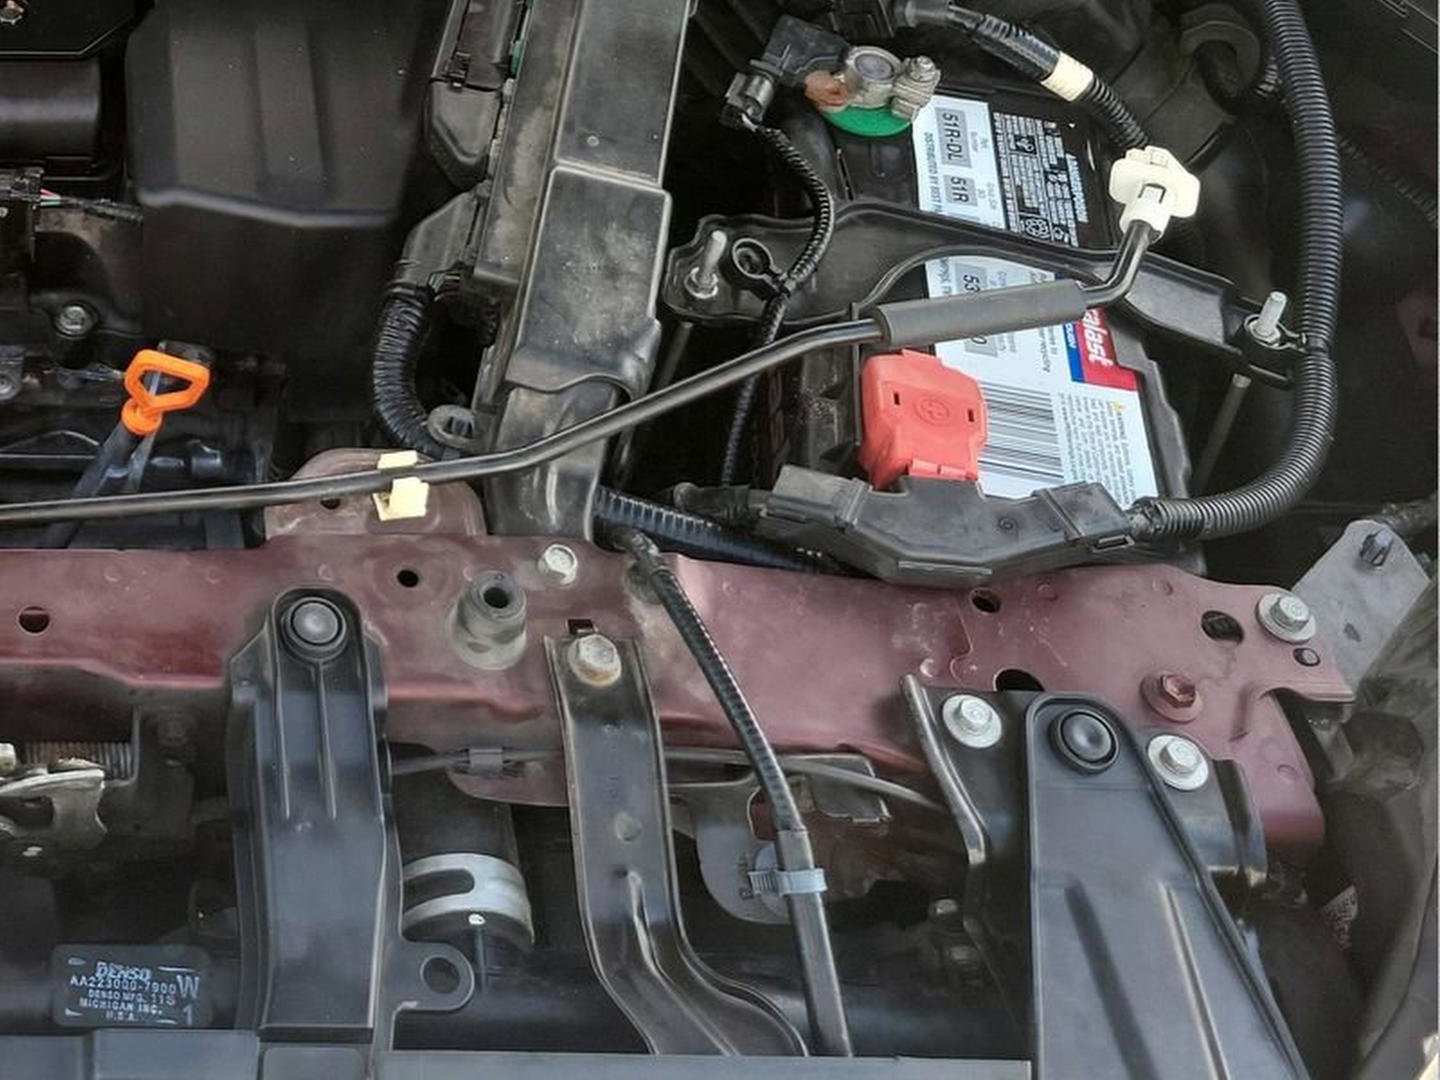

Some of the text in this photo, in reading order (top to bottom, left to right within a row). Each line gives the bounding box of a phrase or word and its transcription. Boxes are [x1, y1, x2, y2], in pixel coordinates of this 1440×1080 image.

[942, 113, 969, 203] 51R-DL 51R
[962, 273, 981, 294] 53
[1082, 308, 1114, 367] alast
[95, 961, 152, 982] DENSO
[176, 974, 200, 999] W
[79, 997, 163, 1015] MICHIGAN INC.
